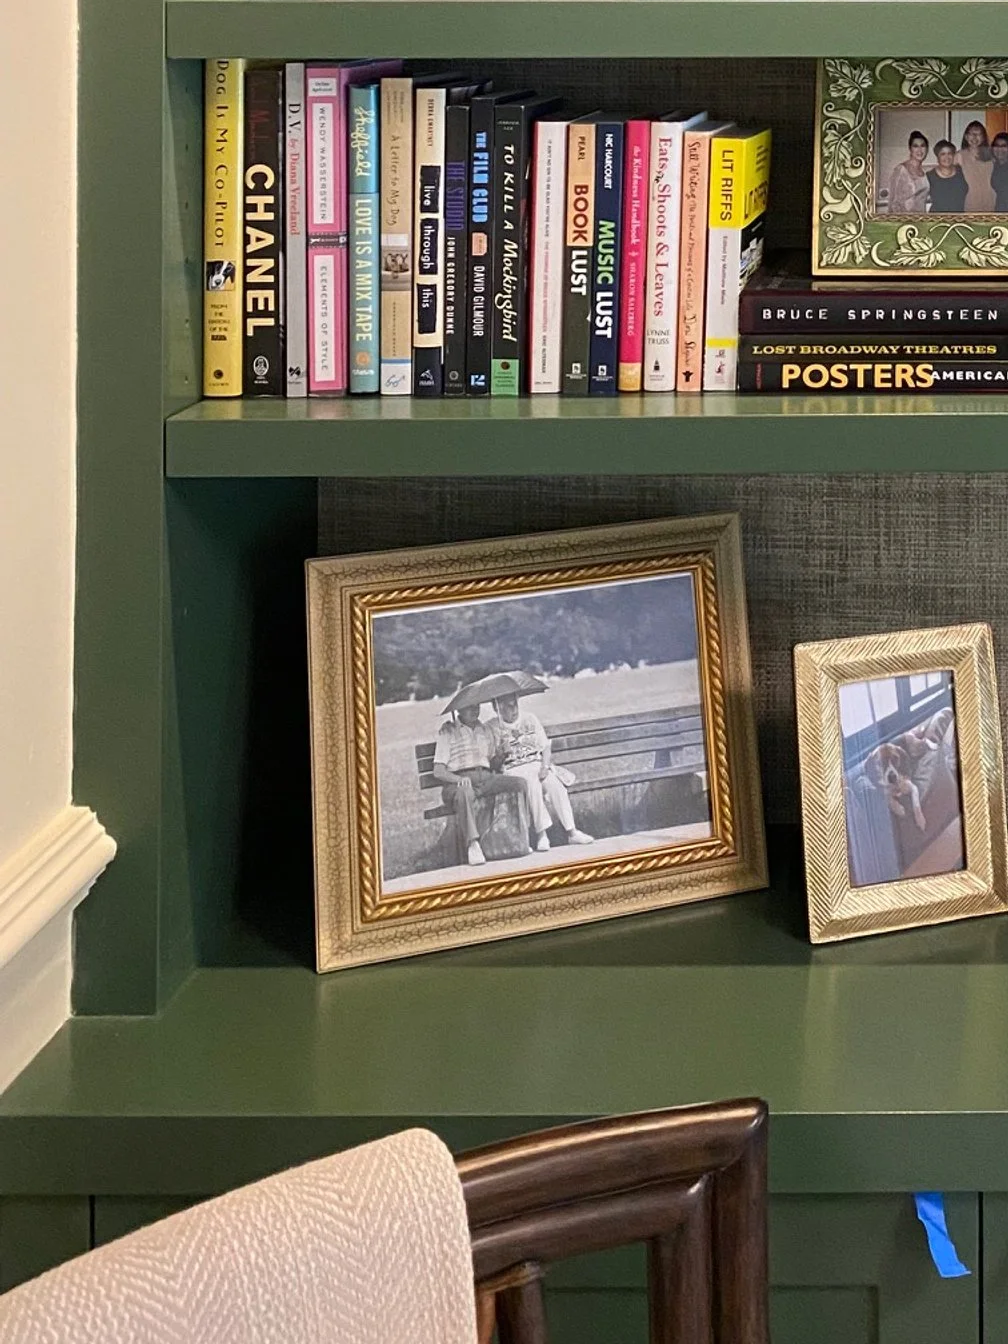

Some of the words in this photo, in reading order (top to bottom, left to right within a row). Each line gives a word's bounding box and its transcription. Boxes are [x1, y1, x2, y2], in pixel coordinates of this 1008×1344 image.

[289, 103, 302, 134] D.V.
[319, 107, 327, 142] WENDY
[289, 138, 300, 150] by
[351, 106, 375, 177] Sheffield
[475, 132, 487, 148] THE
[504, 144, 515, 164] TO
[578, 136, 586, 161] PEARL
[605, 133, 613, 147] NIC
[289, 153, 301, 184] Diana
[391, 146, 400, 171] Letter
[446, 161, 465, 182] THE
[473, 152, 489, 184] FILM
[604, 149, 613, 189] HARCOURT
[721, 149, 734, 173] LIT
[319, 147, 327, 220] WASSERSTEIN
[391, 177, 400, 186] to
[504, 172, 515, 214] KILL
[632, 158, 643, 197] Kindness
[685, 165, 700, 200] Writing
[387, 190, 400, 206] My
[423, 185, 436, 206] live
[446, 187, 464, 231] STUDIO
[472, 188, 488, 223] CLUB
[656, 184, 672, 237] Shoots
[720, 177, 733, 221] RIFFS
[289, 188, 300, 236] Vreeland
[355, 199, 373, 235] LOVE
[386, 209, 400, 227] Dog
[504, 220, 514, 230] A
[572, 184, 589, 243] BOOK
[631, 200, 641, 245] Handbook
[245, 164, 275, 337] CHANEL
[355, 241, 373, 253] IS
[420, 225, 435, 270] through
[446, 237, 456, 258] JOHN
[597, 220, 616, 285] MUSIC
[655, 242, 670, 257] &
[355, 259, 372, 269] A
[473, 265, 485, 293] DAVID
[571, 250, 588, 296] LUST
[629, 262, 637, 296] SHARON
[355, 274, 372, 301] MIX
[446, 262, 456, 302] GREGORY
[494, 239, 518, 342] Mockingbird
[654, 263, 669, 317] Leaves
[421, 288, 433, 308] this
[321, 323, 328, 334] OF
[355, 304, 372, 342] TAPE
[445, 305, 455, 335] DUNNE
[472, 296, 484, 336] GILMOUR
[595, 291, 614, 338] LUST
[762, 308, 829, 320] BRUCE
[848, 309, 998, 320] SPRINGSTEEN
[752, 345, 797, 354] LOST
[800, 345, 900, 354] BROADWAY
[903, 345, 997, 354] THEATRES
[782, 363, 935, 389] POSTERS
